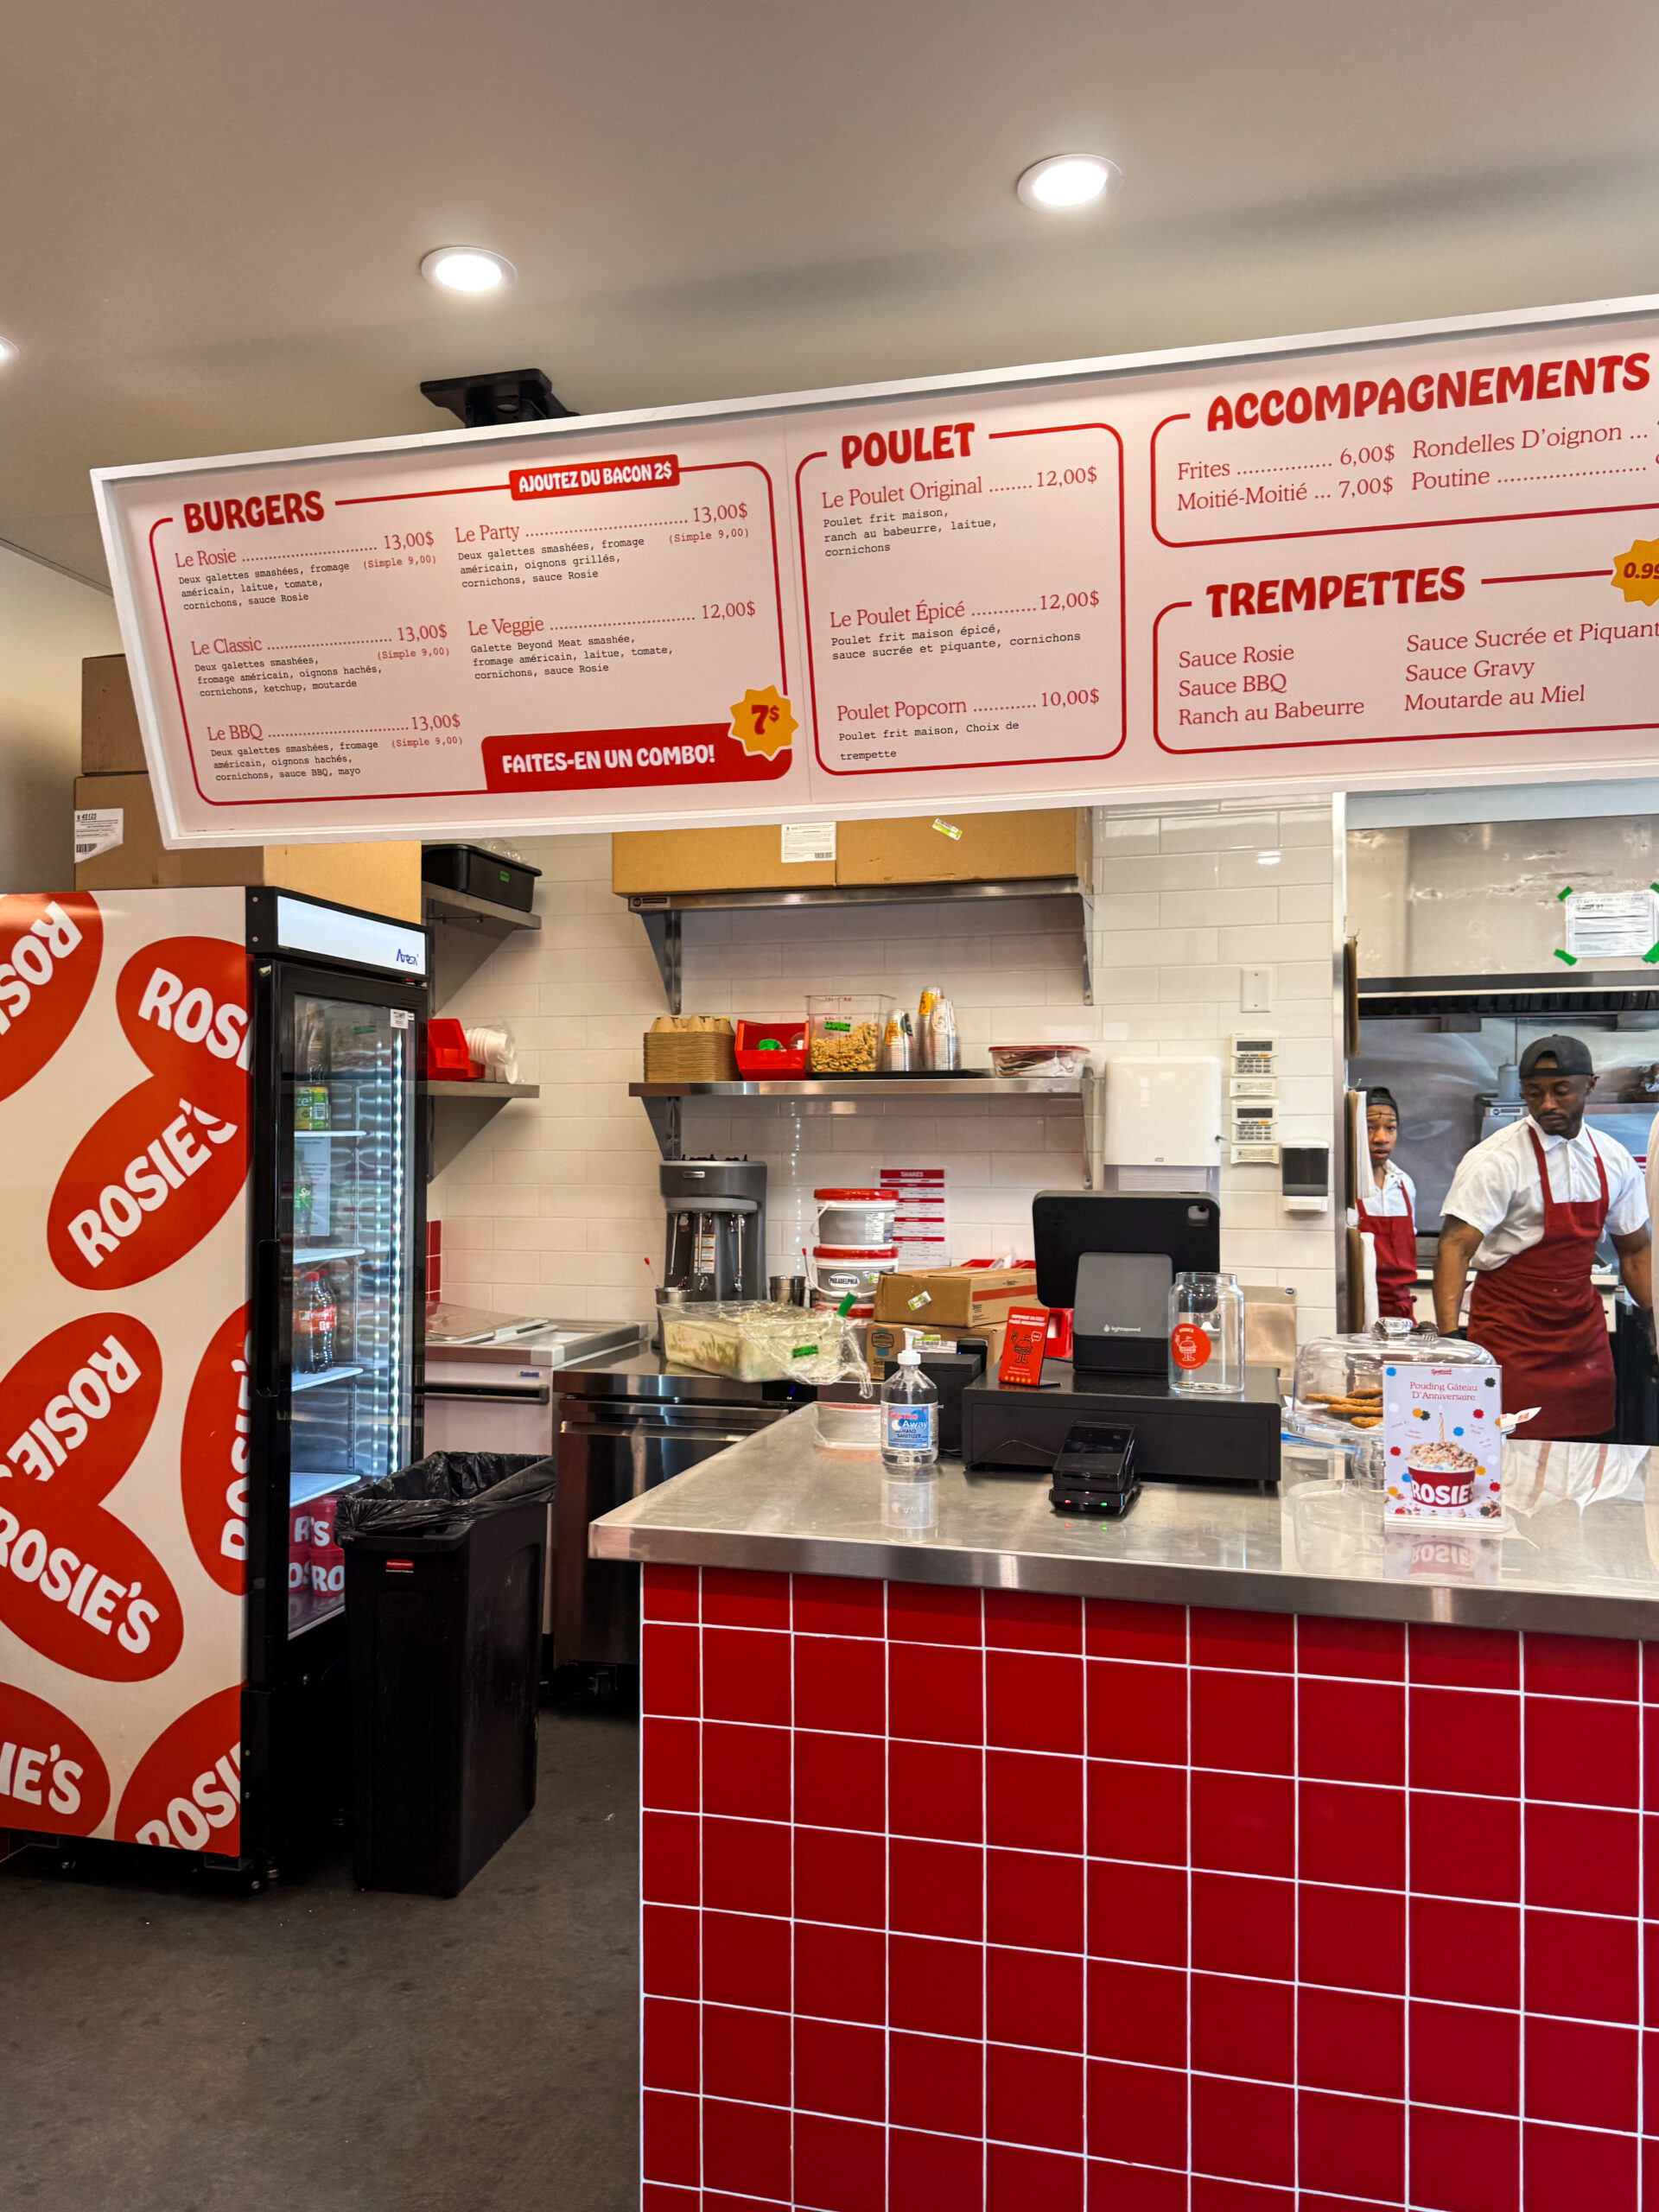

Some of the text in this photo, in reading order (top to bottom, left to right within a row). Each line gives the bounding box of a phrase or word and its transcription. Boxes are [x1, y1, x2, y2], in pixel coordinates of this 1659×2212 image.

[1207, 353, 1650, 432] ACCOMPAGNEMENTS
[842, 423, 975, 469] POULET
[1412, 426, 1622, 459] Rondelles D'oignon
[1178, 443, 1395, 480] Frites 6,00$
[519, 461, 672, 493] AJOUTEZ DU BACON 2$
[821, 465, 1097, 509] Le Poulet Original 12,00$
[1411, 468, 1491, 491] Poutine
[1177, 474, 1394, 512] Moitié-Moitié 7,00$
[183, 491, 325, 533] BURGERS
[454, 501, 748, 543] Le Party 13,00$
[823, 509, 948, 528] Poulet frit maison,
[669, 528, 748, 545] (Simple 9,00)
[823, 519, 996, 543] ranch au babeurre, laitue,
[174, 530, 435, 569] Le Rosie 13,00$
[457, 538, 645, 561] Deux galettes smashées, fromage
[825, 544, 891, 557] cornichons
[178, 563, 350, 585] Deux galettes smashées, fromage
[364, 555, 436, 570] (Simple 9,00)
[460, 554, 620, 575] américain, oignons grillés,
[181, 579, 322, 598] américain, laitue, tomate,
[461, 569, 599, 588] cornichons, sauce Rosie
[183, 592, 309, 611] cornichons, sauce Rosie
[1206, 565, 1465, 618] TREMPETTES
[467, 600, 756, 637] Le Veggie 12,00$
[830, 589, 1100, 628] Le Poulet Épicé 12,00$
[190, 623, 448, 656] Le Classic 13,00$
[470, 634, 634, 653] Galette Beyond Meat smashée,
[830, 623, 1001, 646] Poulet frit maison épicé,
[832, 632, 1081, 660] sauce sucrée et piquante, cornichons
[1406, 634, 1468, 652] Sauce
[1474, 626, 1547, 648] Sucrée
[1553, 627, 1573, 643] et
[194, 656, 318, 672] Deux galettes smashées,
[378, 646, 449, 661] (Simple 9,00)
[473, 647, 672, 667] fromage américain, laitue, tomate,
[1179, 644, 1294, 669] Sauce Rosie
[197, 664, 382, 684] fromage américain, oignons hachés,
[474, 663, 609, 680] cornichons, sauce Rosie
[1405, 659, 1535, 683] Sauce Gravy
[200, 679, 357, 697] cornichons, ketchup, moutarde
[1179, 673, 1287, 697] Sauce BBQ
[836, 687, 1100, 721] Poulet Popcorn 10,00$
[1404, 683, 1585, 712] Moutarde au Miel
[751, 704, 779, 735] 7$
[1179, 701, 1364, 726] Ranch au Babeurre
[207, 713, 461, 741] Le BBQ 13,00$
[839, 721, 1020, 741] Poulet frit maison, Choix de
[502, 745, 715, 773] FAITES-EN UN COMBO!
[840, 750, 897, 761] trempette
[1410, 1382, 1478, 1392] Pouding Gâteau
[1412, 1391, 1476, 1401] D'Anniversaire
